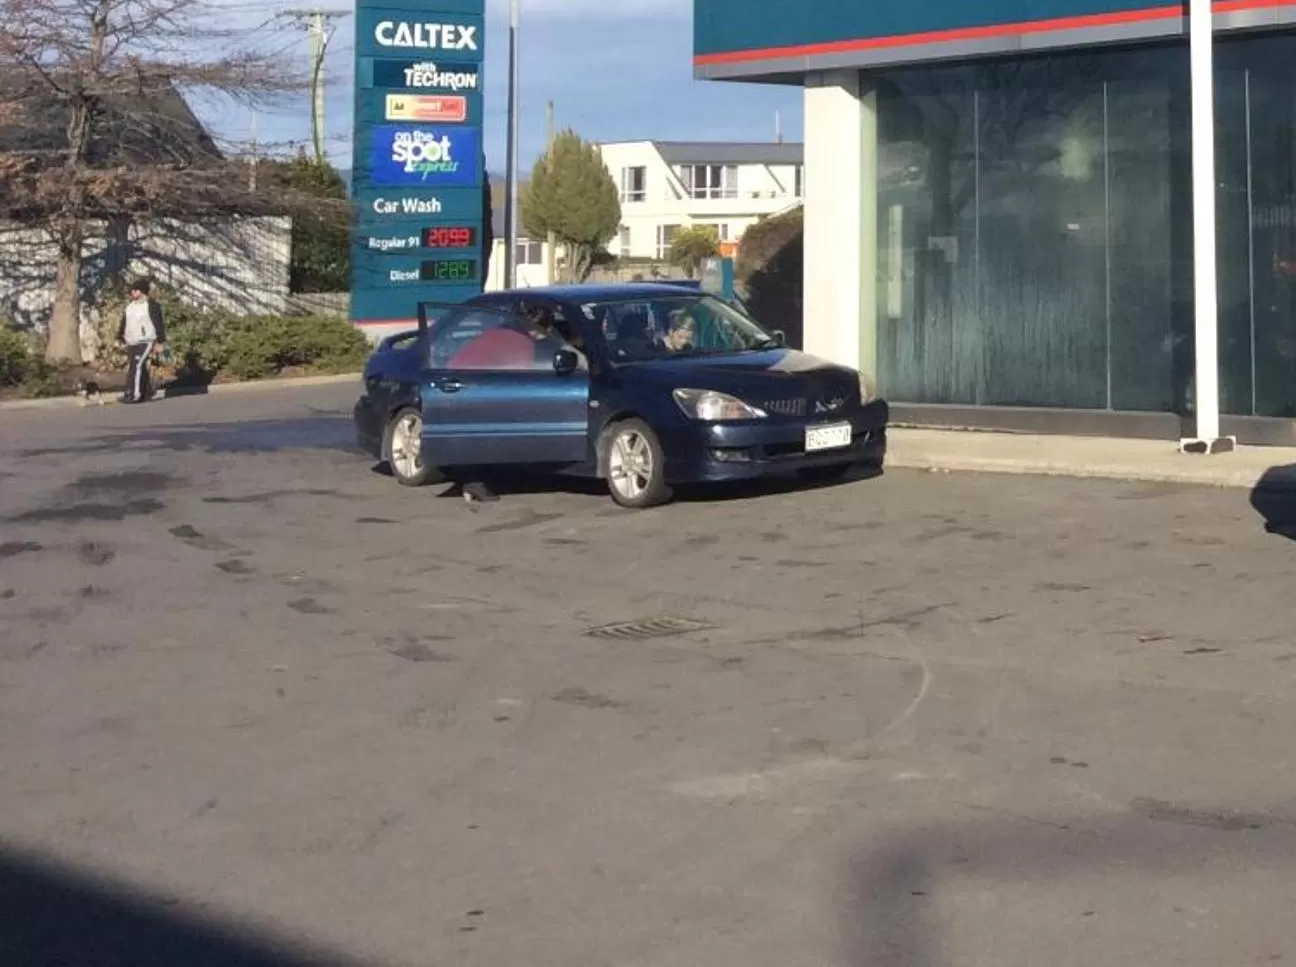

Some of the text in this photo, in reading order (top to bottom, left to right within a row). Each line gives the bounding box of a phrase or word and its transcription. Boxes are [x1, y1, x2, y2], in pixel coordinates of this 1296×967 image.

[374, 20, 478, 50] CALTEX
[403, 68, 477, 91] TECHRON
[394, 130, 435, 143] on the
[373, 197, 442, 214] Car Wash
[368, 236, 406, 251] Regular
[407, 235, 420, 248] 91
[389, 268, 420, 281] Diesel
